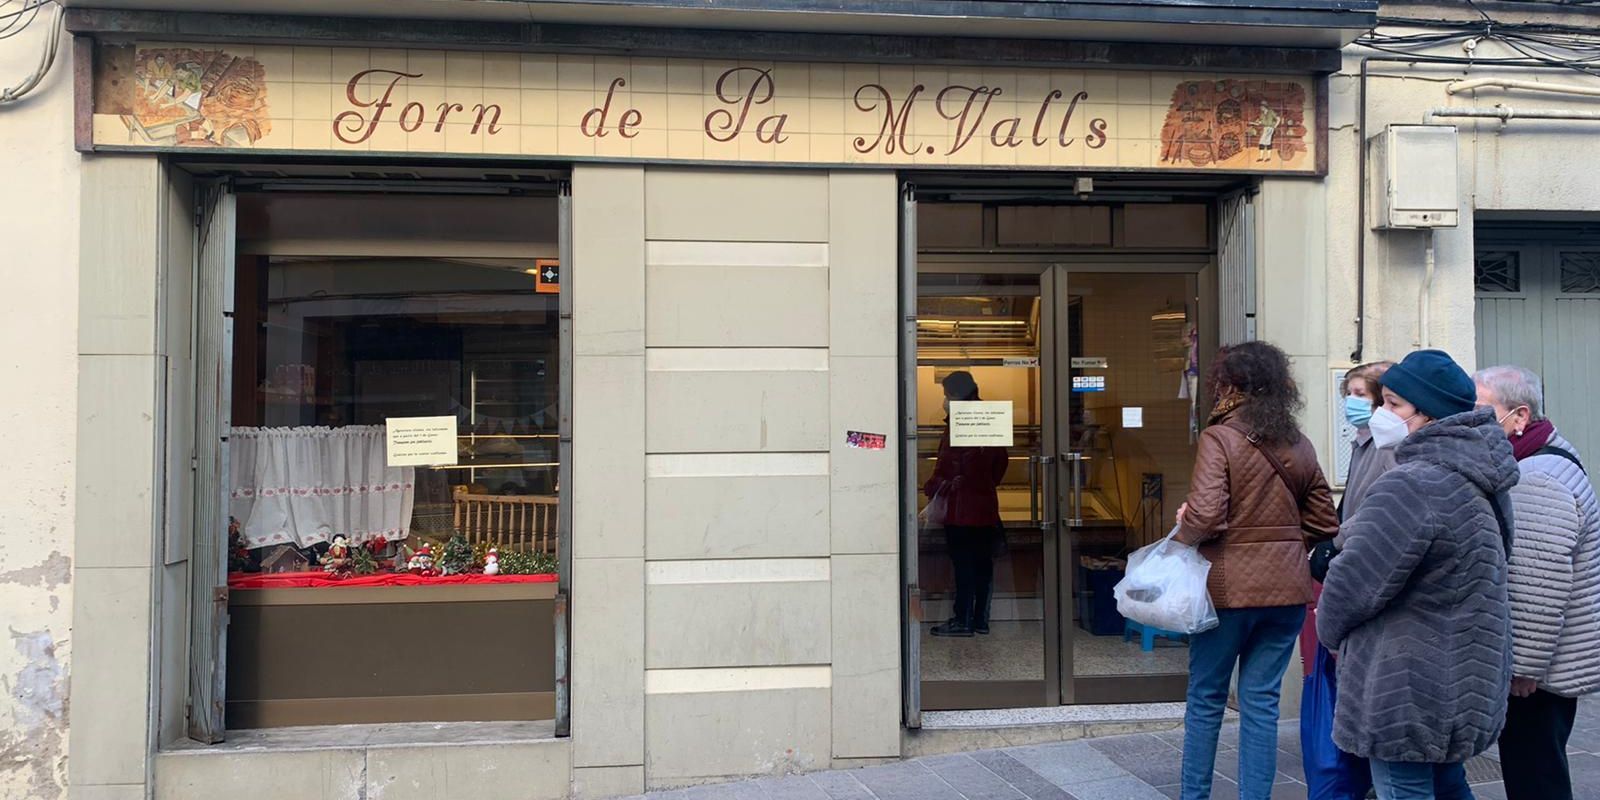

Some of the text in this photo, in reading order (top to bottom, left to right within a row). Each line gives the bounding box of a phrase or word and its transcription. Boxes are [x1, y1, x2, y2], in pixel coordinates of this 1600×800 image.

[332, 68, 502, 144] Forn
[580, 77, 642, 139] de
[704, 66, 789, 145] Pa
